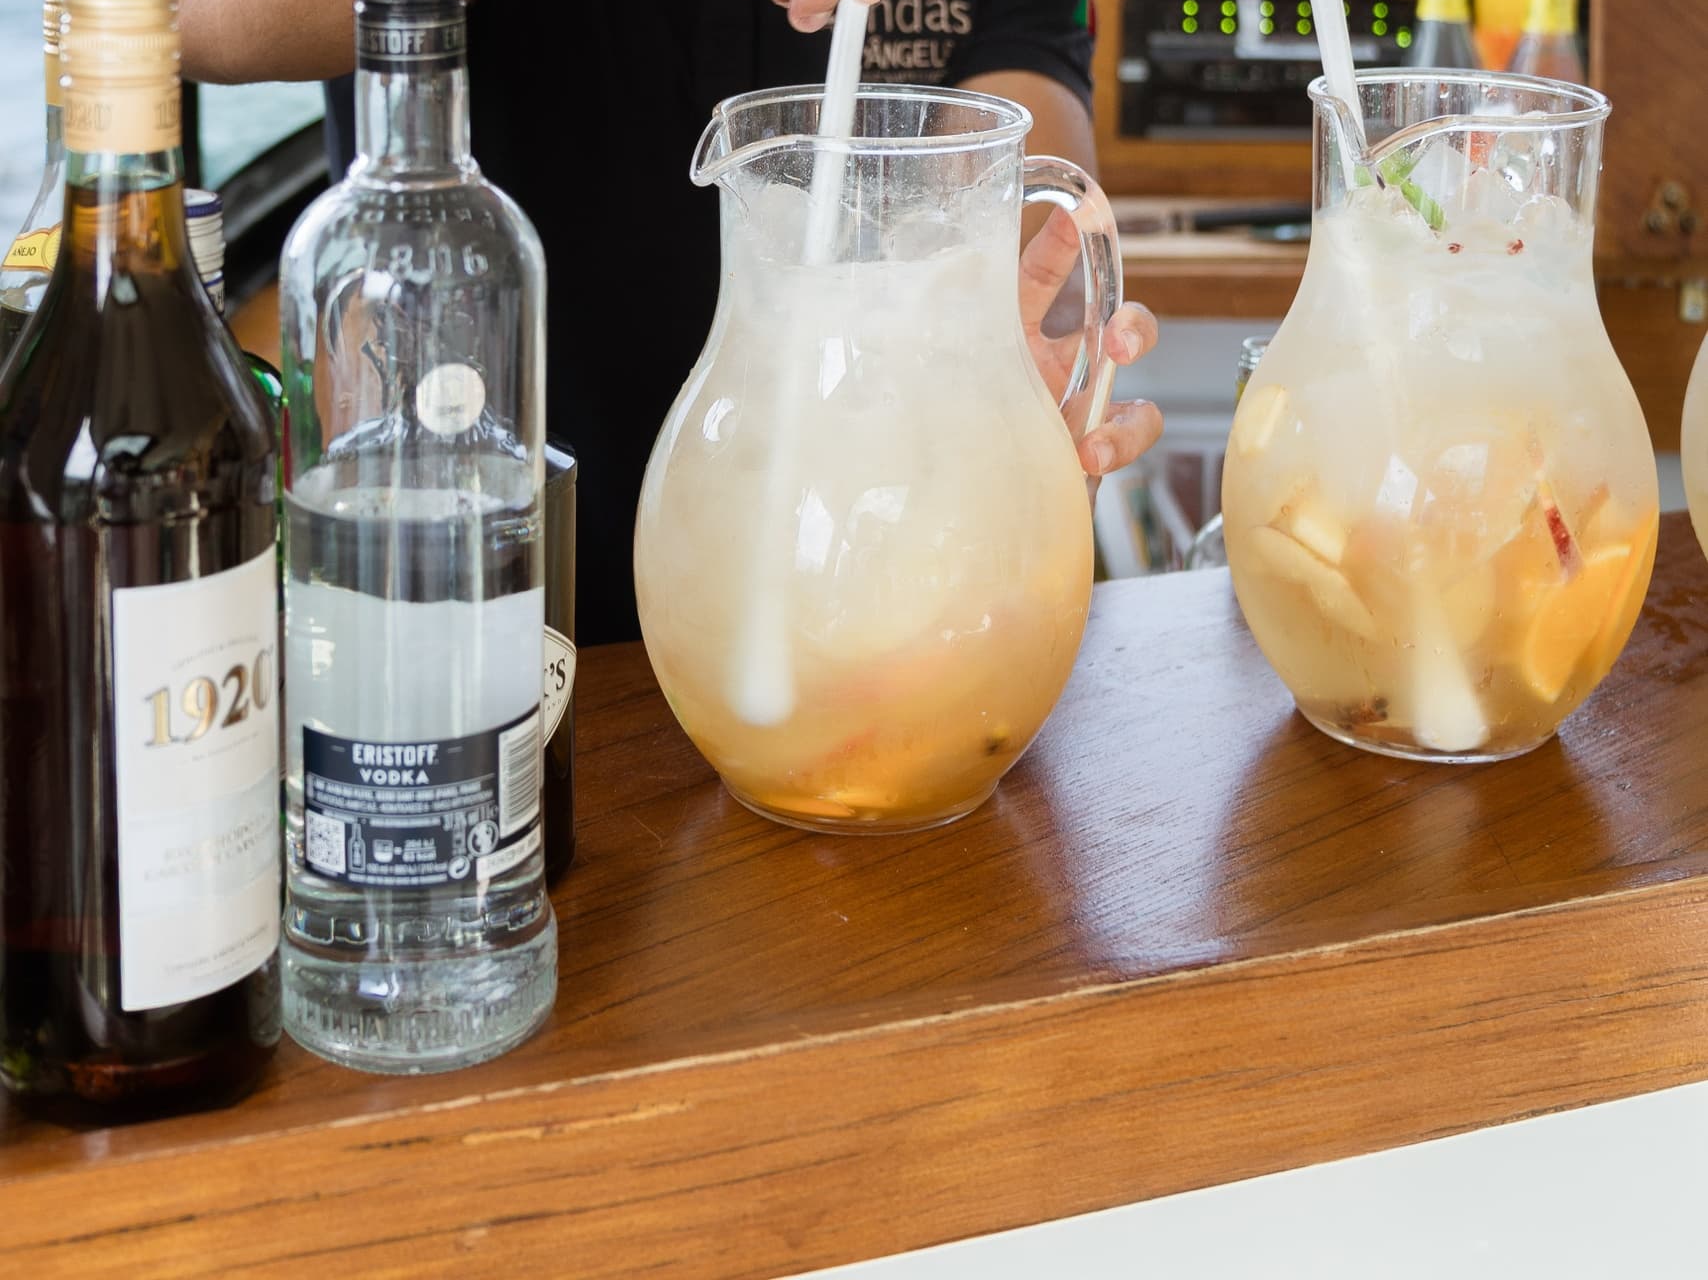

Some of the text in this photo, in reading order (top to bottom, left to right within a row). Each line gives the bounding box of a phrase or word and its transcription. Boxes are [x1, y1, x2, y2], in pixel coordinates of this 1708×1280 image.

[143, 648, 272, 748] 1920
[352, 743, 438, 767] ERISTOFF
[359, 769, 430, 786] VODKA
